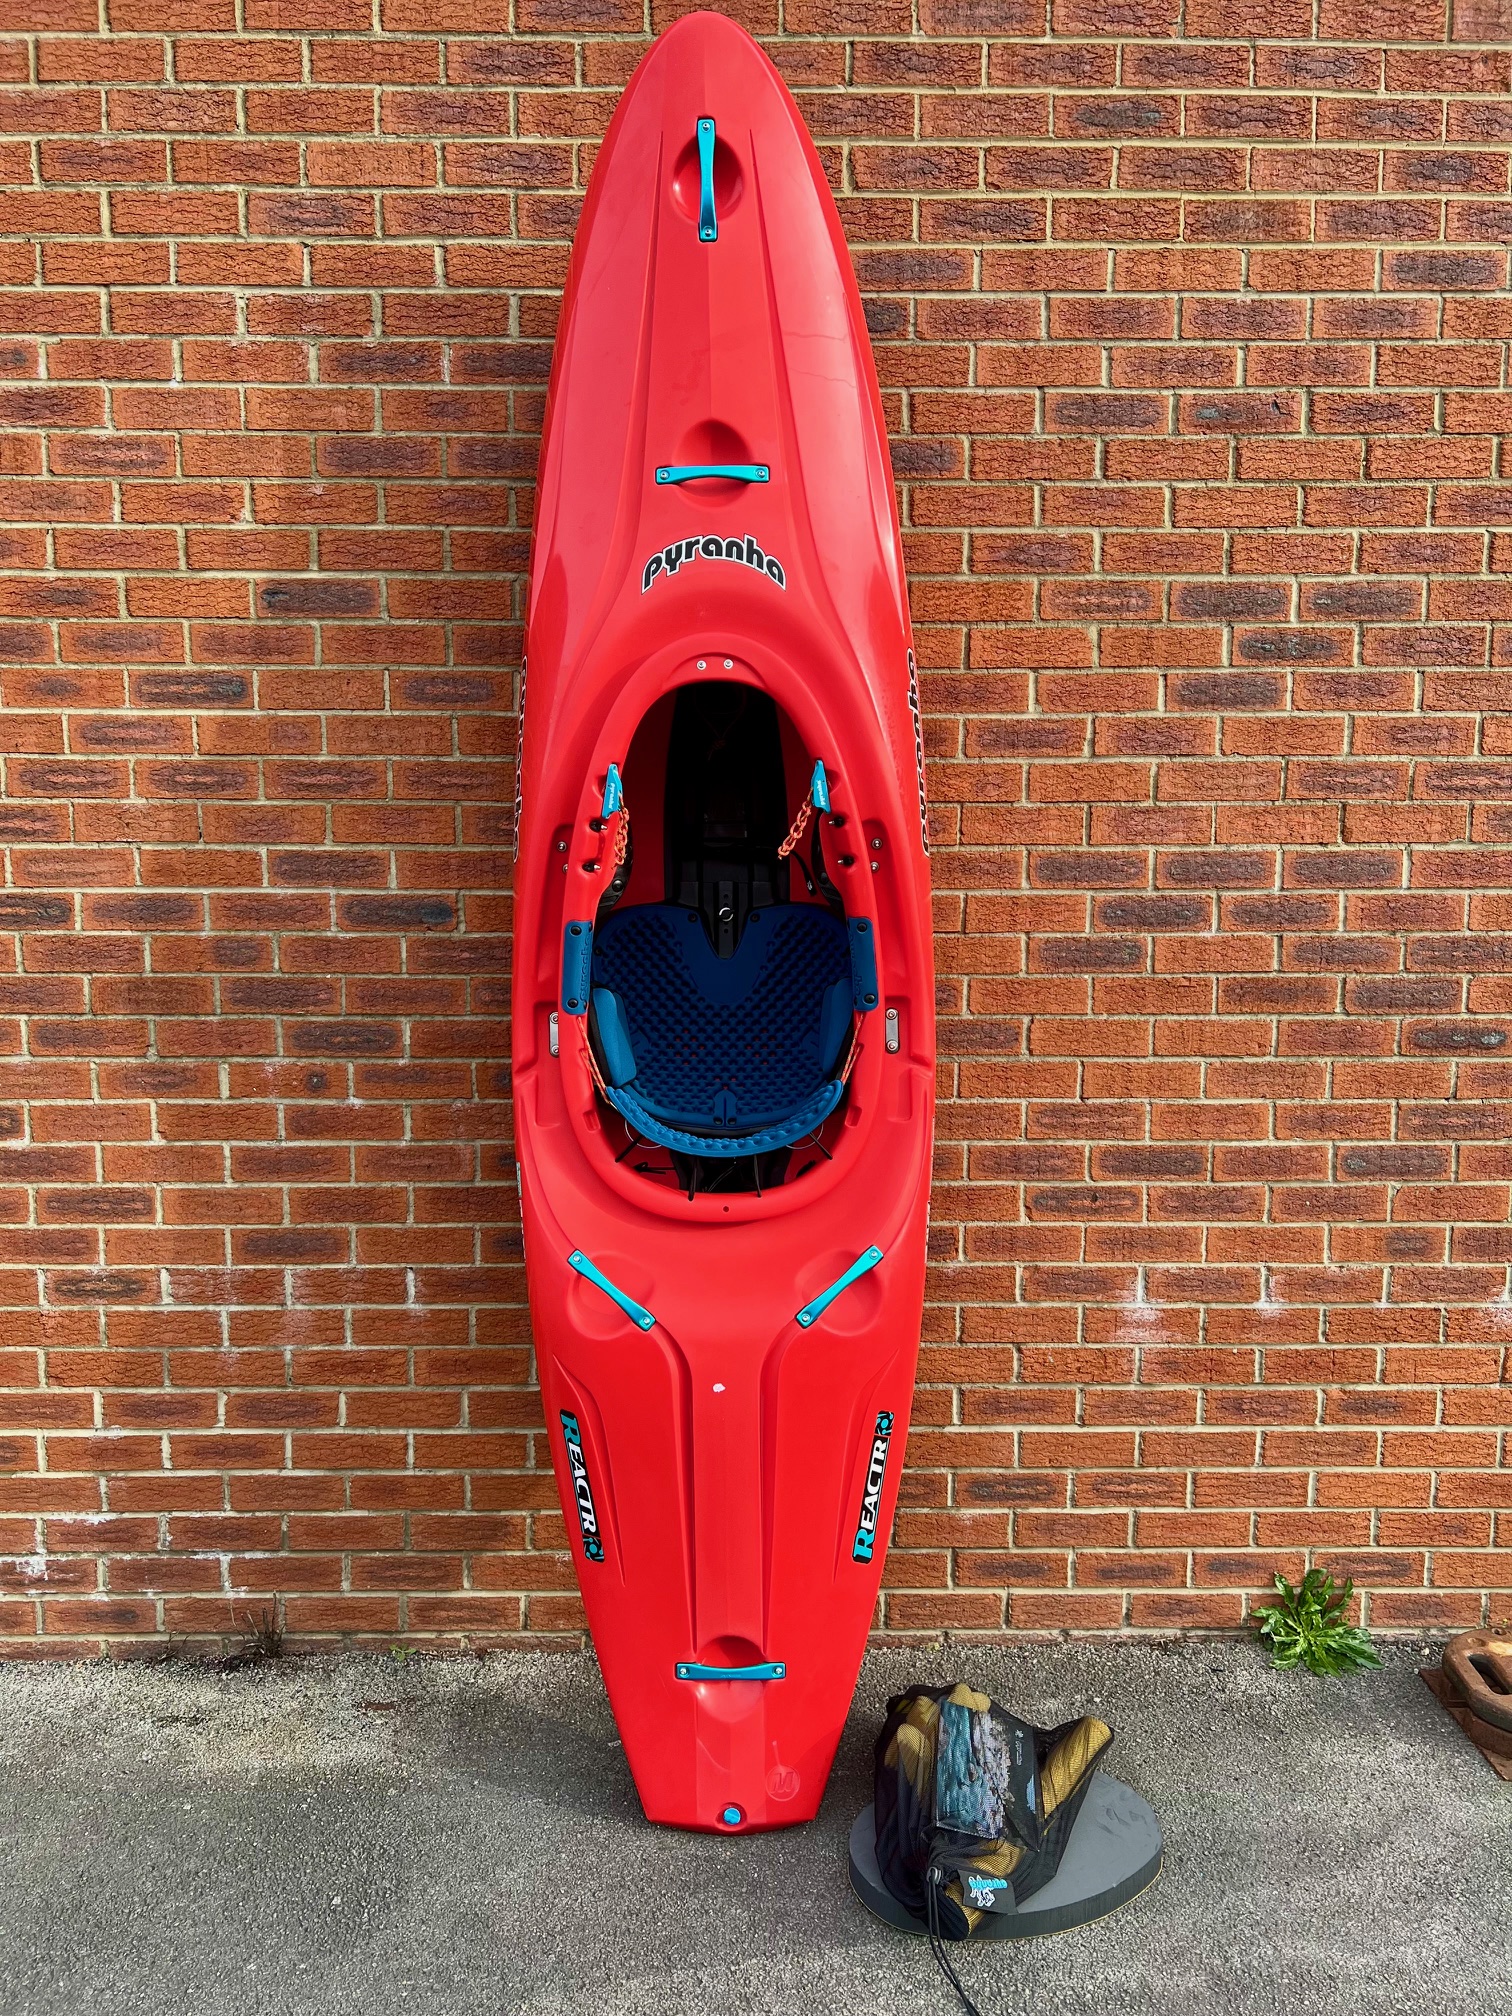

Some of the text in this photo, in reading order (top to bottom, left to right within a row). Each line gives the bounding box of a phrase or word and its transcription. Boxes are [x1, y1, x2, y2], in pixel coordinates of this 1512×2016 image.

[641, 533, 786, 595] pyranha
[561, 1413, 597, 1533] REACTR
[853, 1439, 888, 1560] REACTR
